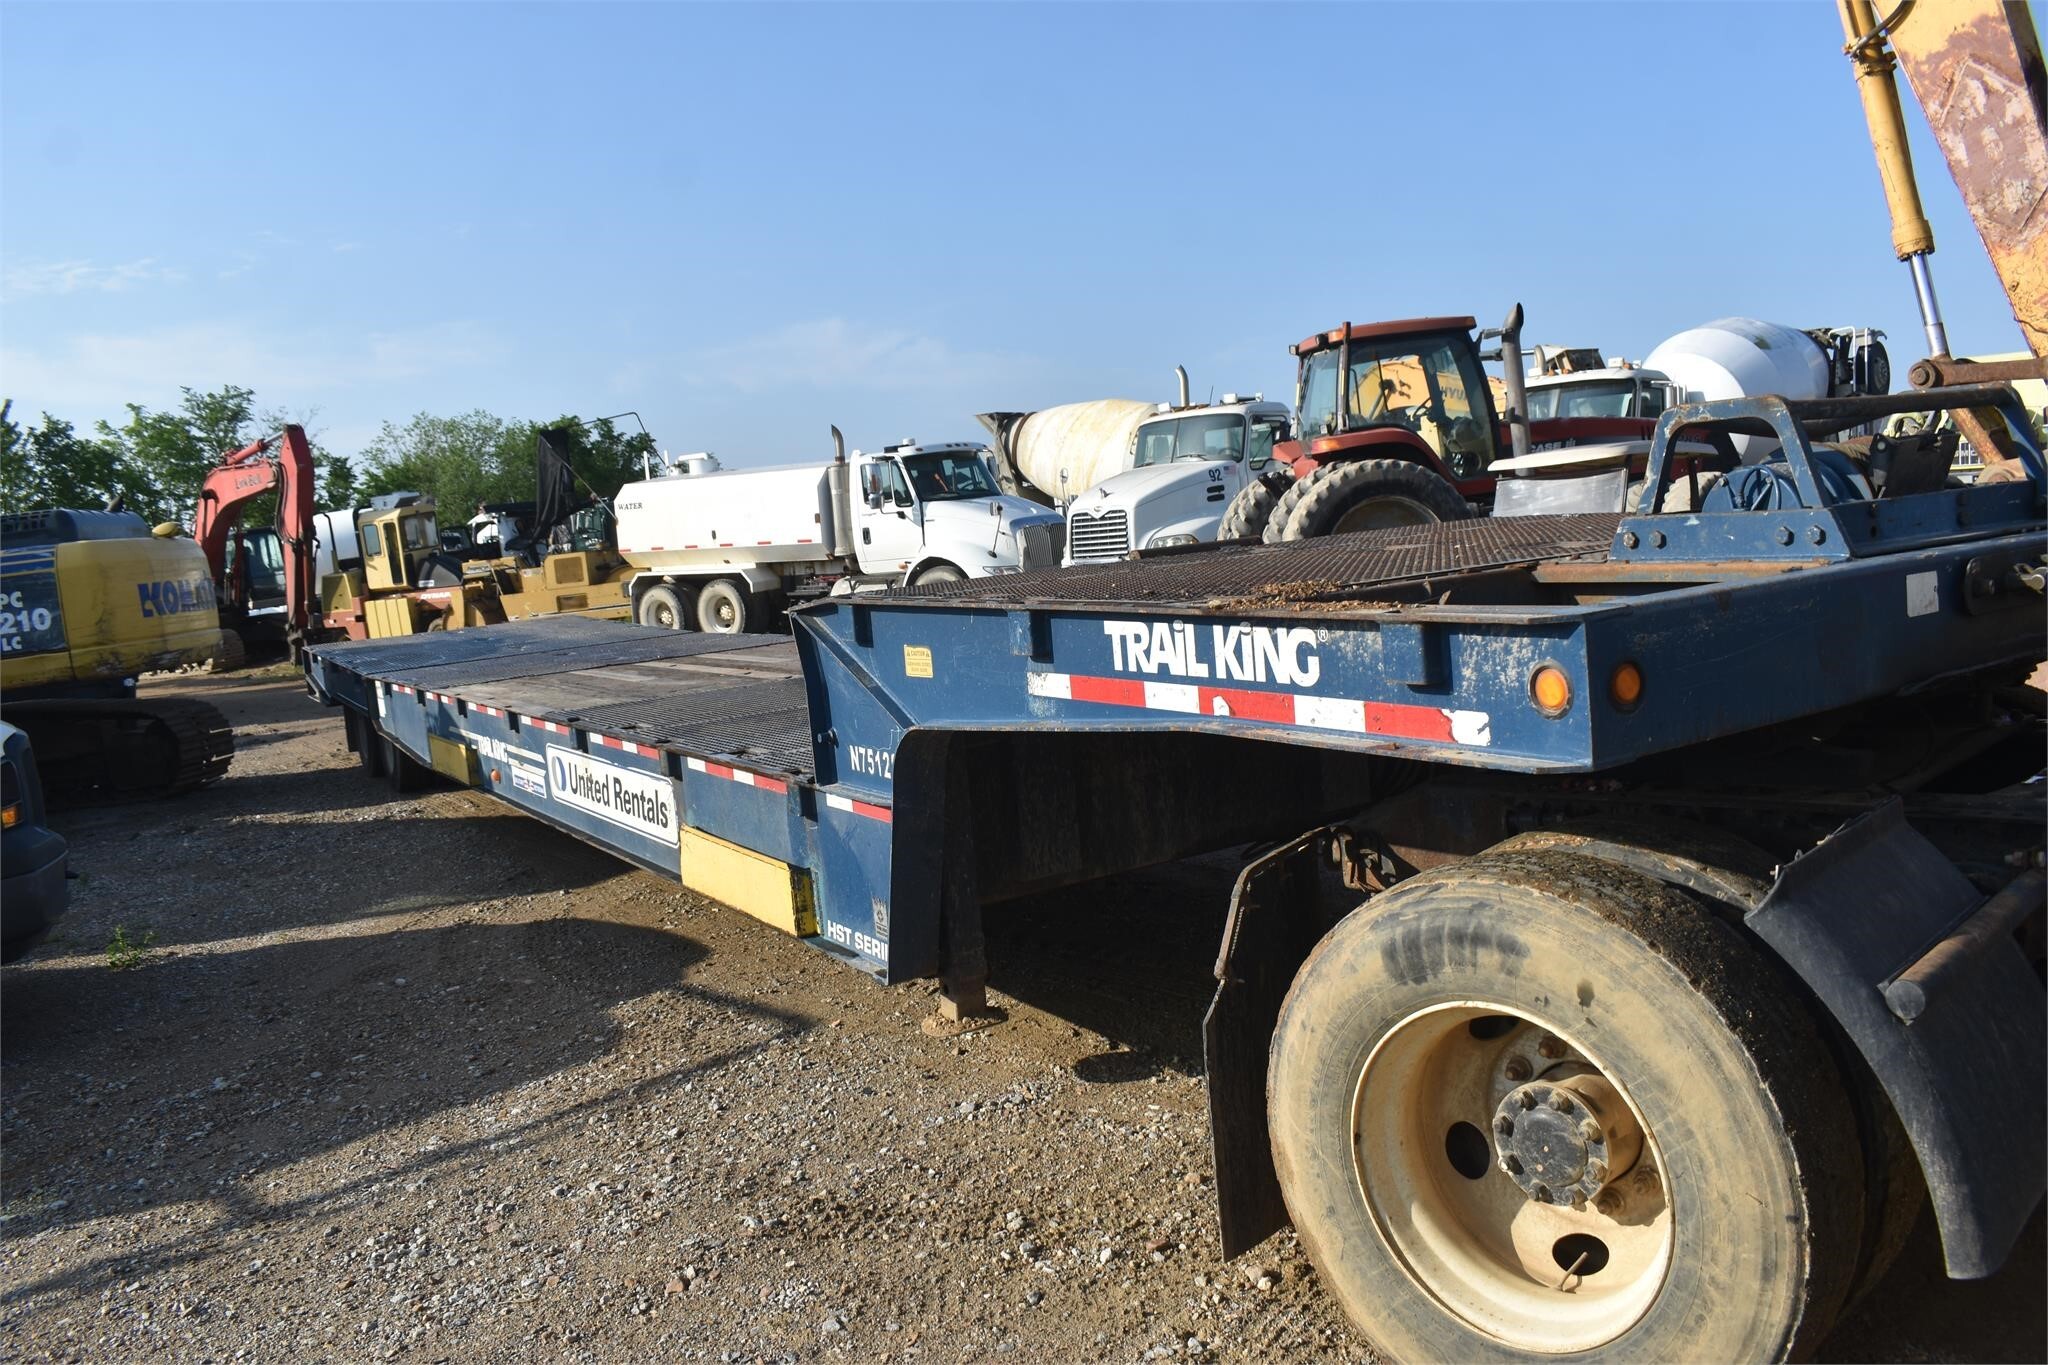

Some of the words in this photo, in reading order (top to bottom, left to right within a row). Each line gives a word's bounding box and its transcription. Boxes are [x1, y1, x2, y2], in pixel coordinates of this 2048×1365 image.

[1208, 468, 1223, 482] 92
[618, 502, 643, 510] WATER
[849, 744, 895, 779] N7512
[568, 762, 611, 808] United
[613, 776, 669, 829] Rentals
[827, 919, 852, 946] HST
